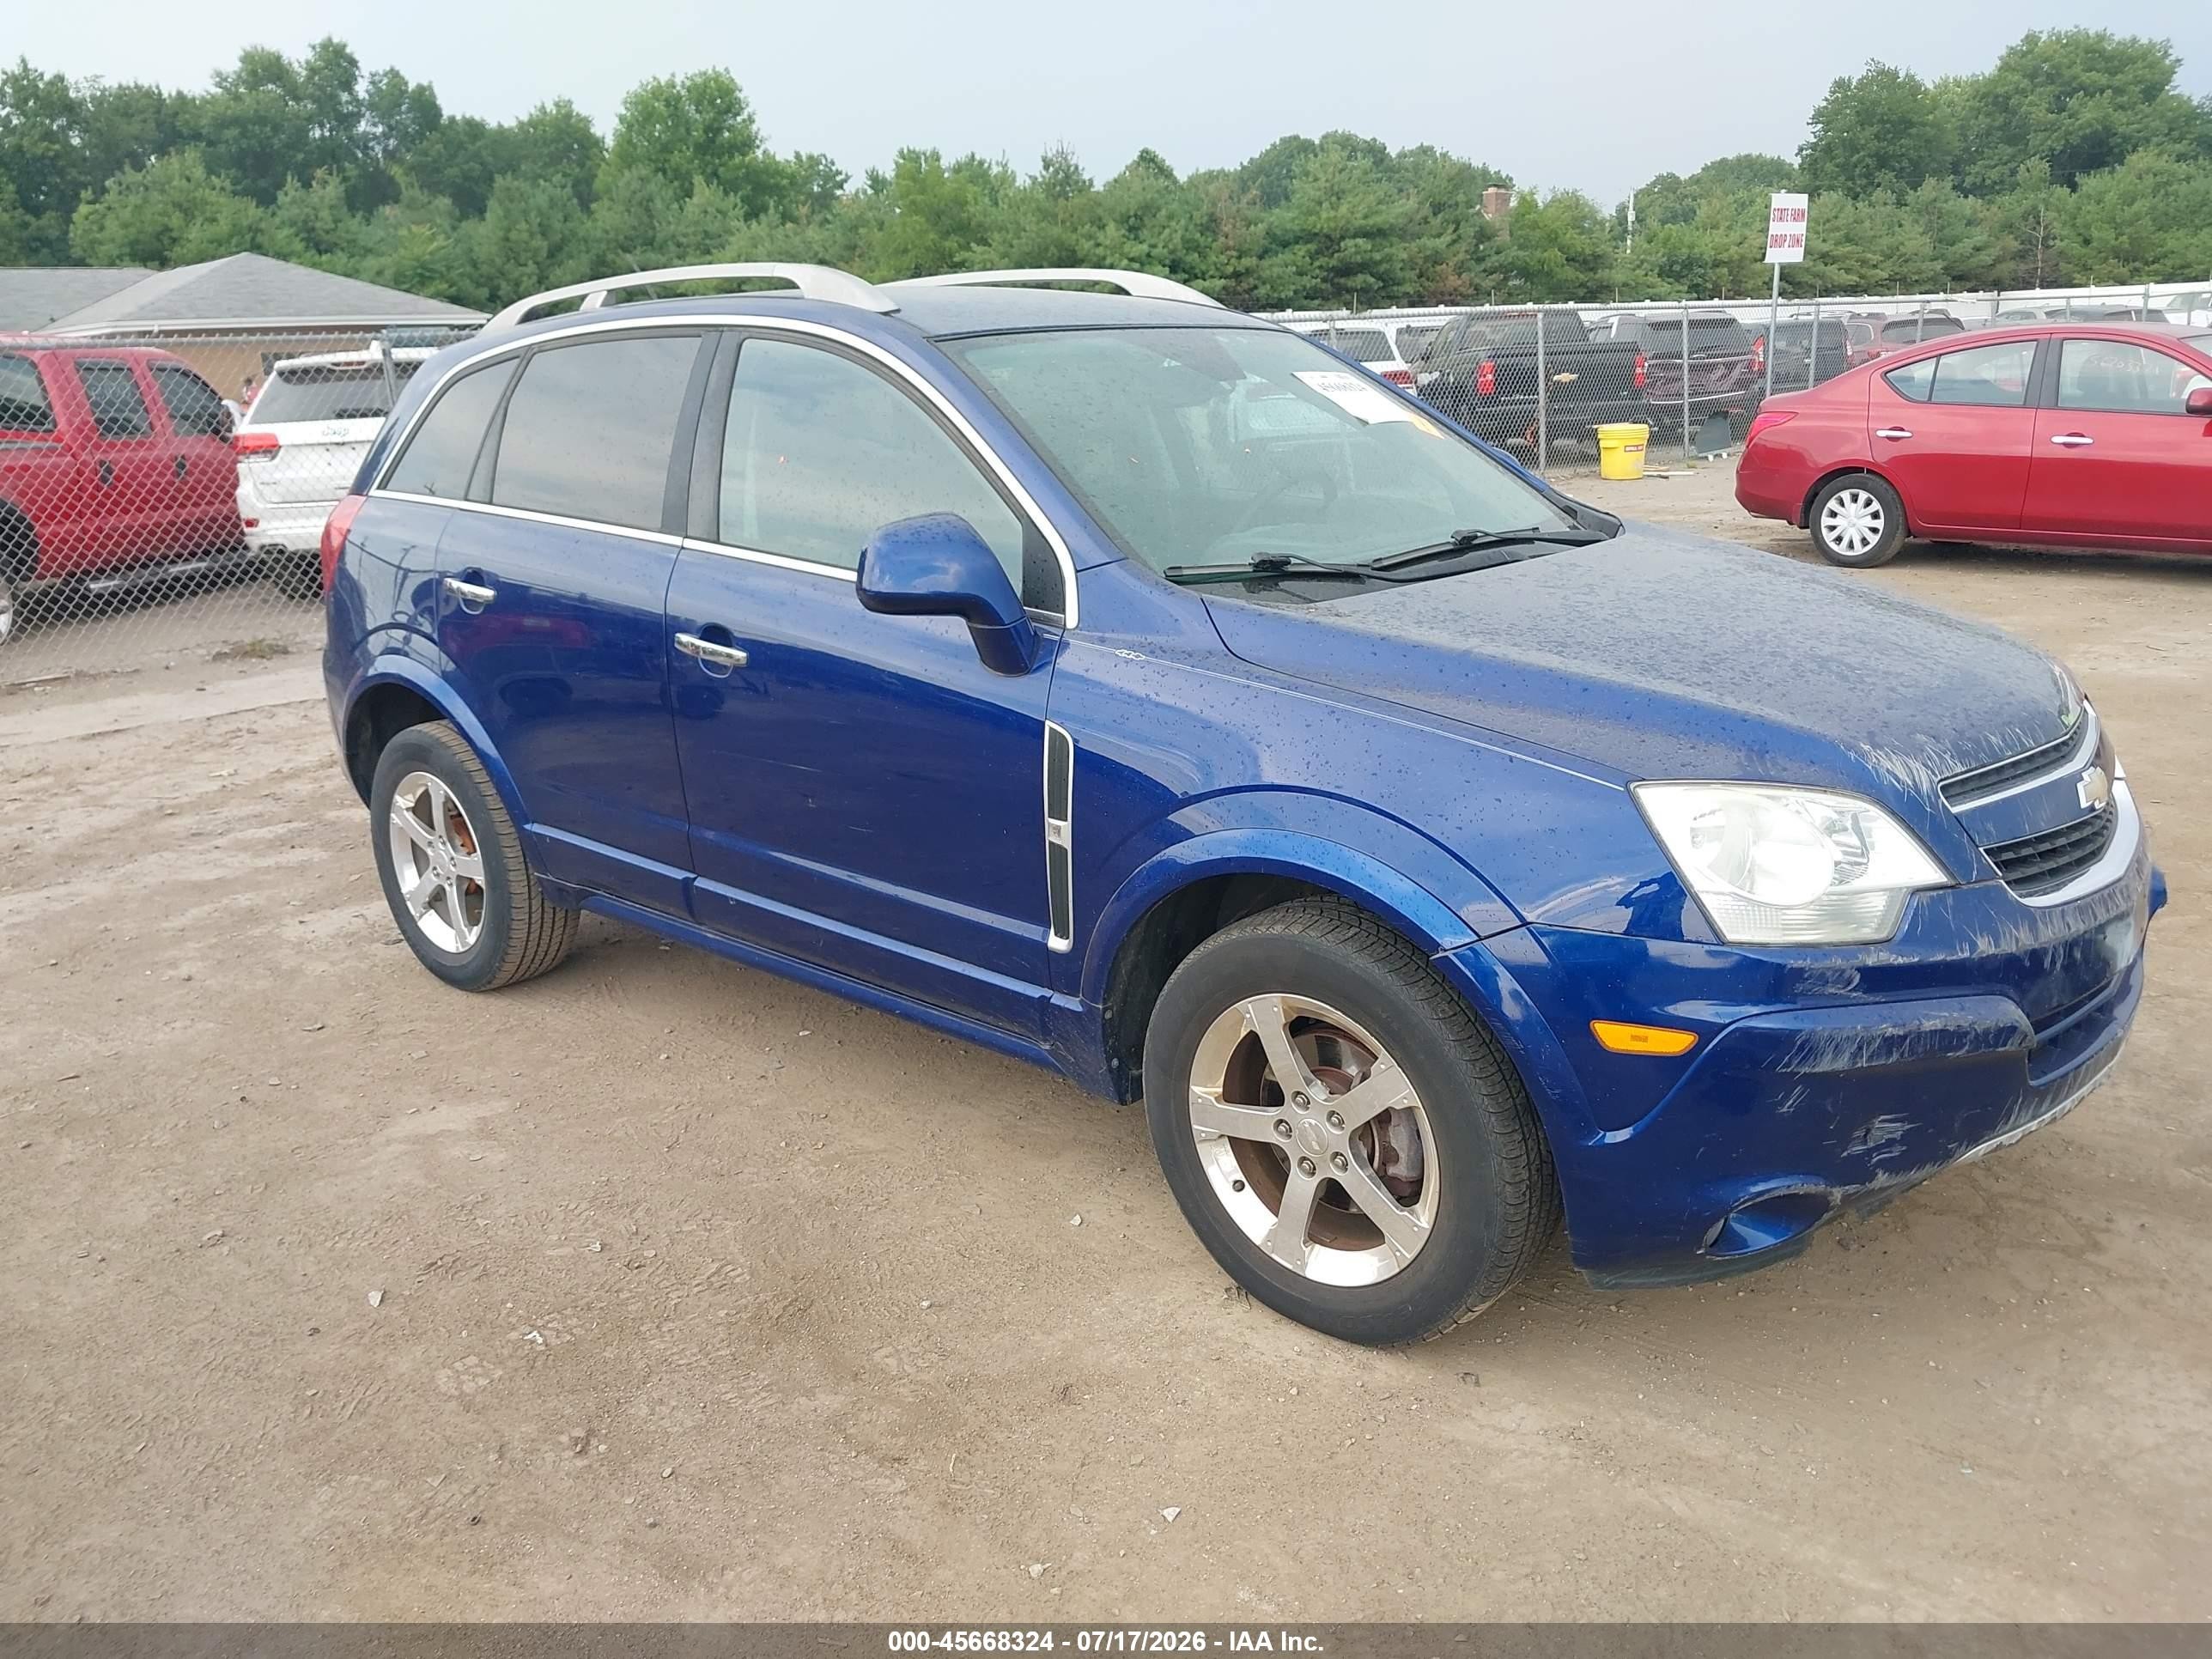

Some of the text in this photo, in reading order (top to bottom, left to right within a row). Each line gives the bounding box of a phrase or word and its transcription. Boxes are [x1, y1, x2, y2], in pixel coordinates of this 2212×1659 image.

[1772, 207, 1806, 222] STATE FARM
[1769, 233, 1804, 248] DROP ZONE
